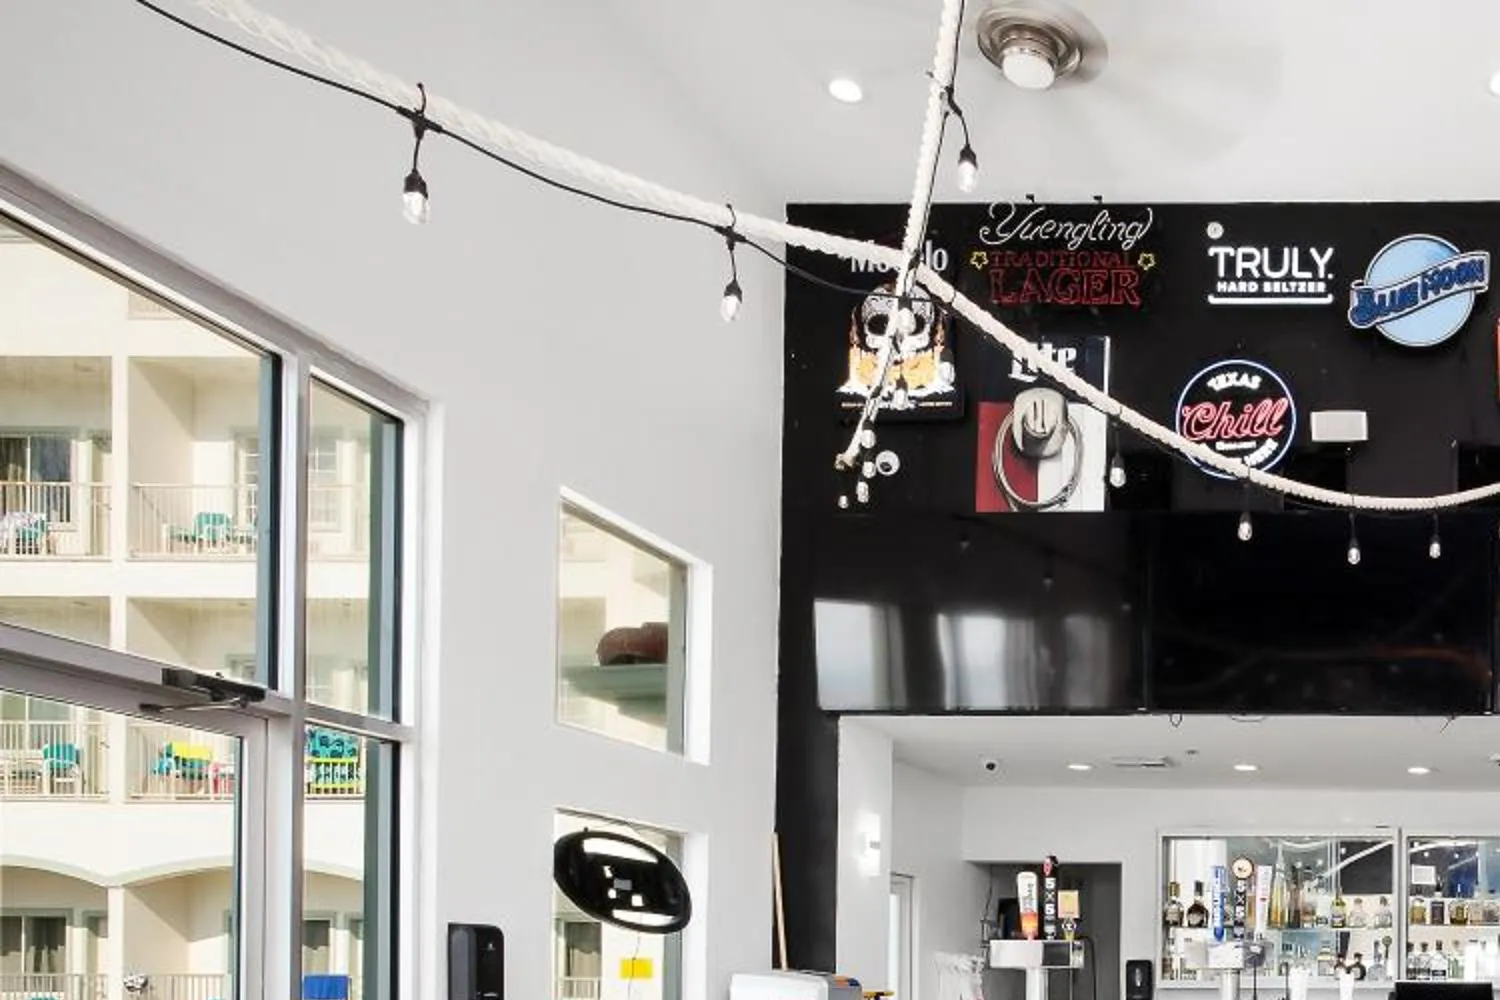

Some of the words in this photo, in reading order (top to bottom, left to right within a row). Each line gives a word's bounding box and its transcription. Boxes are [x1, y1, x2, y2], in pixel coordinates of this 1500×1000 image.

[979, 201, 1153, 250] Yuengling
[990, 250, 1133, 268] TRADITIONAL
[988, 266, 1142, 306] LAGER
[1217, 281, 1259, 293] HARD
[1263, 281, 1327, 293] SELTZER
[1350, 281, 1420, 327] BLUE
[1420, 257, 1487, 302] MOON
[1206, 371, 1262, 392] TEXAS
[1182, 398, 1288, 441] Chill
